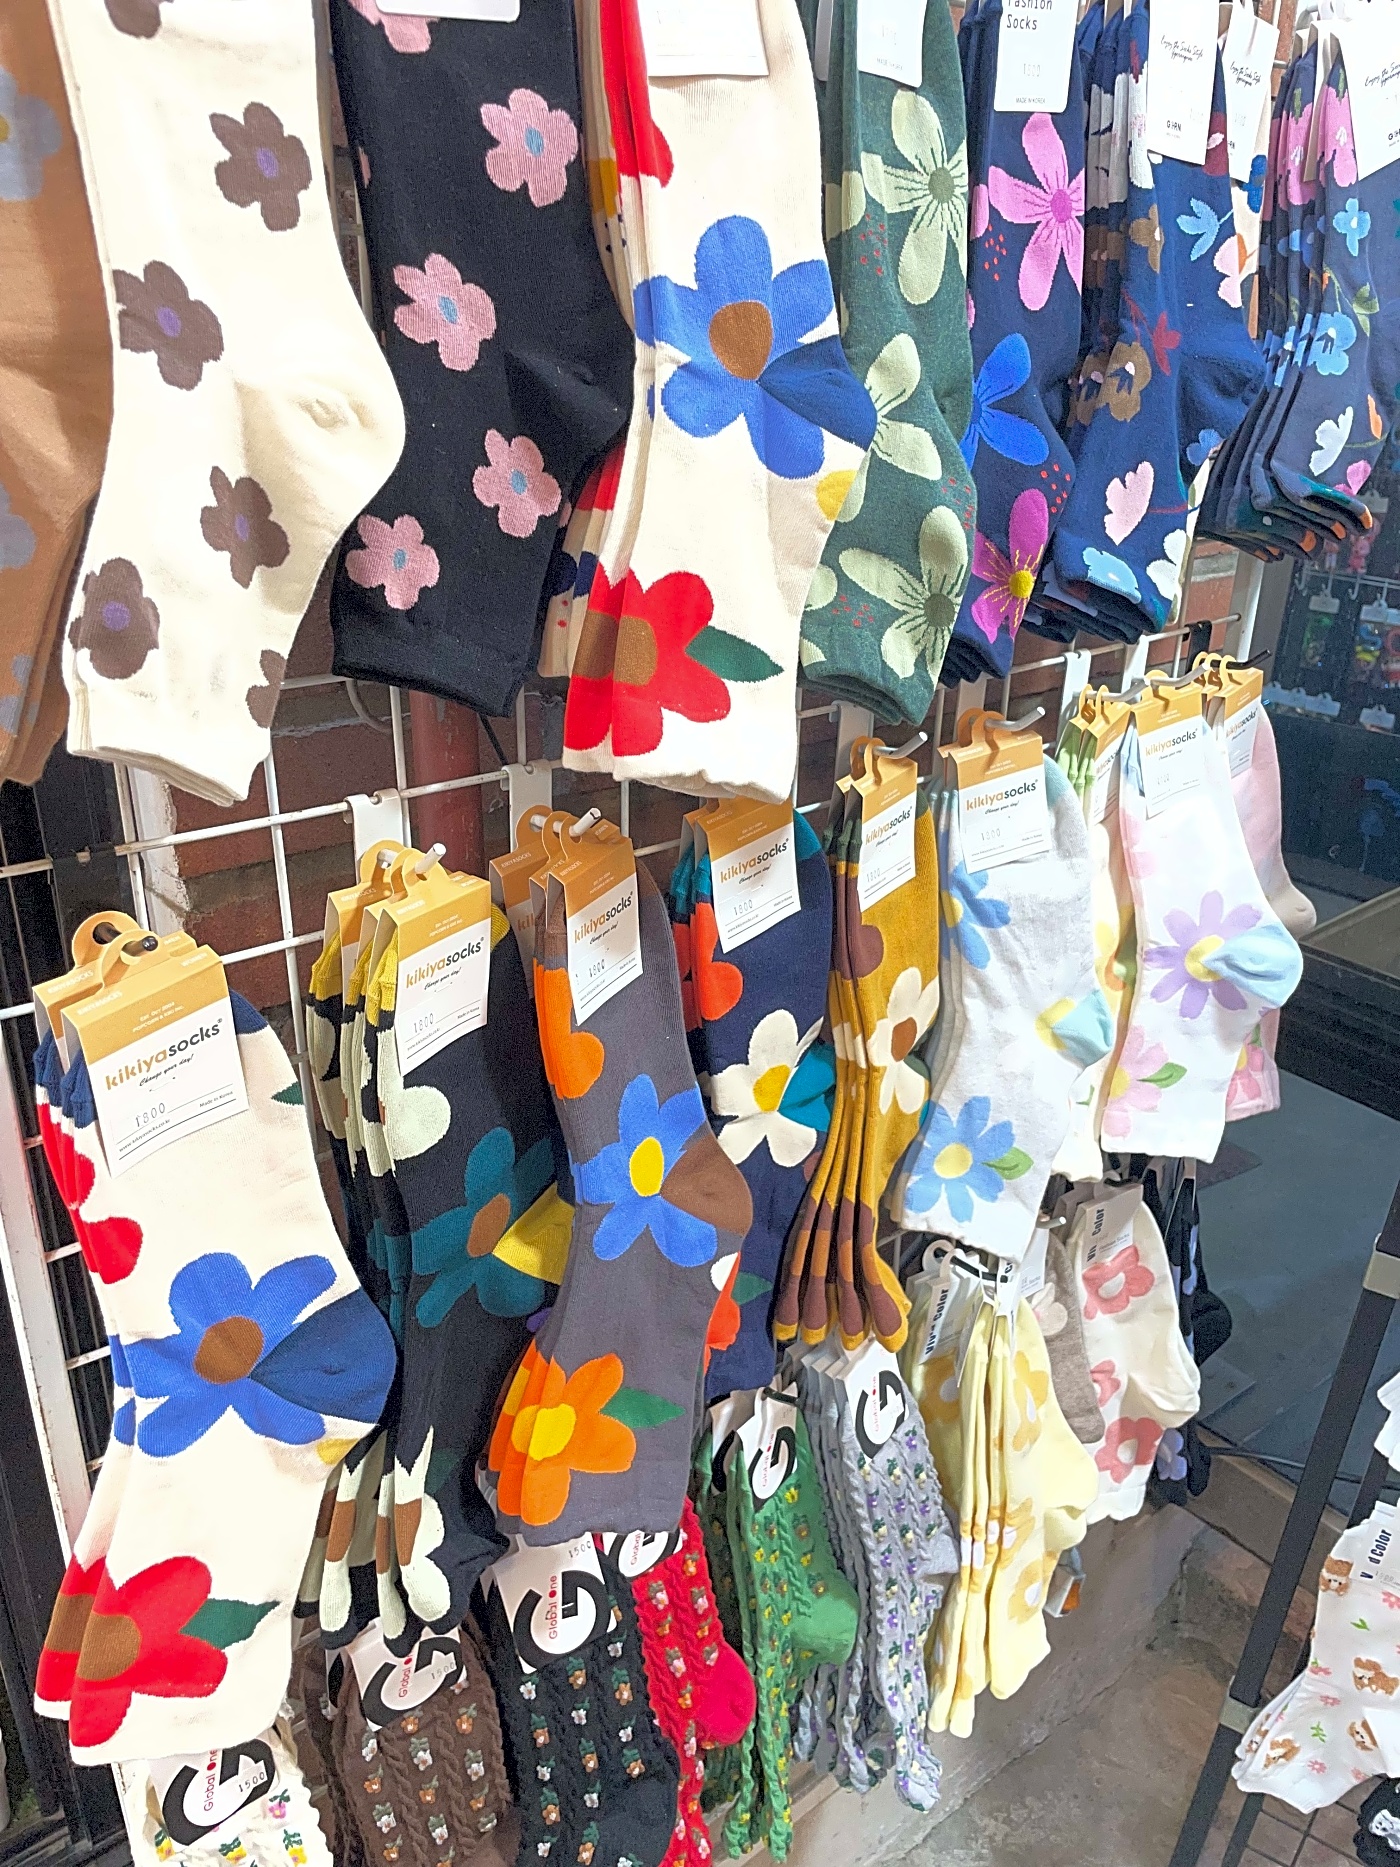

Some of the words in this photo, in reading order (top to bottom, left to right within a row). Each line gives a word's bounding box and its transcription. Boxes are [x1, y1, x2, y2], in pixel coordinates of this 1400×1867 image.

[1006, 14, 1038, 30] Socks
[733, 899, 753, 917] 1800
[413, 1012, 435, 1034] 1800
[139, 1069, 163, 1087] Change
[163, 1061, 178, 1075] your
[135, 1101, 167, 1128] 1800
[1092, 1208, 1105, 1236] Color
[933, 1288, 949, 1322] Color
[630, 1533, 641, 1566] Global
[1370, 1528, 1392, 1558] Color
[548, 1603, 558, 1640] Global
[398, 1667, 411, 1698] Global
[203, 1773, 216, 1812] Global
[238, 1771, 266, 1792] 1500
